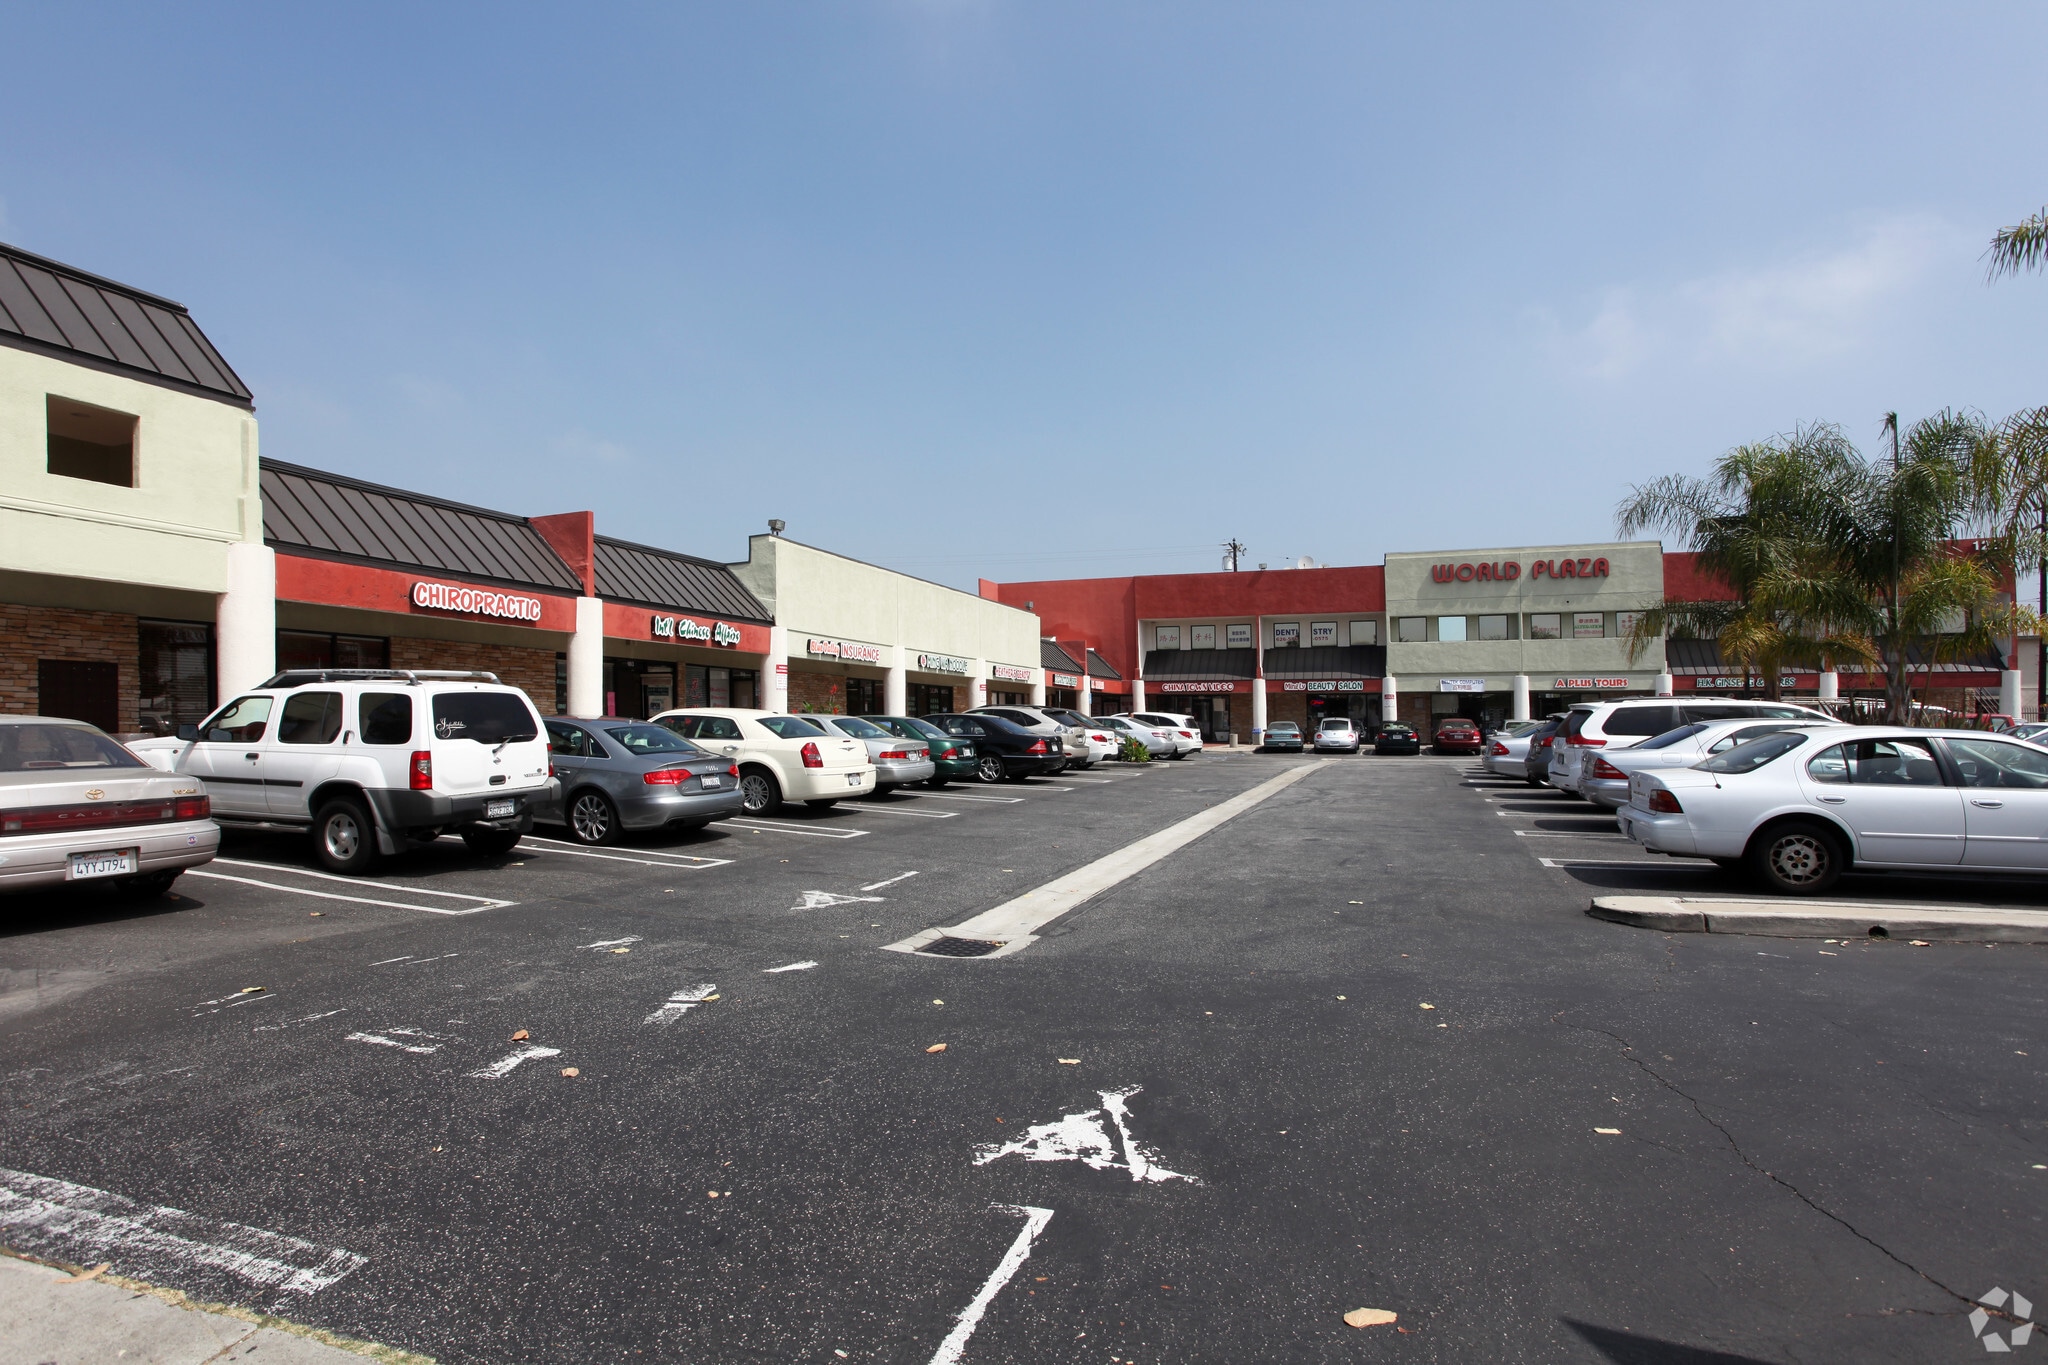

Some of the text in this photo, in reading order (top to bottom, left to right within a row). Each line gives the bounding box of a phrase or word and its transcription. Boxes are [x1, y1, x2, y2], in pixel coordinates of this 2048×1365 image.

[1432, 557, 1610, 583] WORLD PLAZA
[414, 582, 540, 620] CHIROPRACTIC
[679, 619, 711, 640] Chinese
[715, 622, 740, 646] Affairs
[1275, 628, 1299, 636] DENTI
[840, 643, 880, 662] INSURANCE
[1208, 682, 1234, 691] VIDEO
[1308, 681, 1336, 691] BEAUTY
[1338, 681, 1363, 691] SALON
[1555, 678, 1628, 688] A PLUS TOURS
[1715, 677, 1755, 688] GINSEG
[77, 859, 126, 874] 4YYJ794
